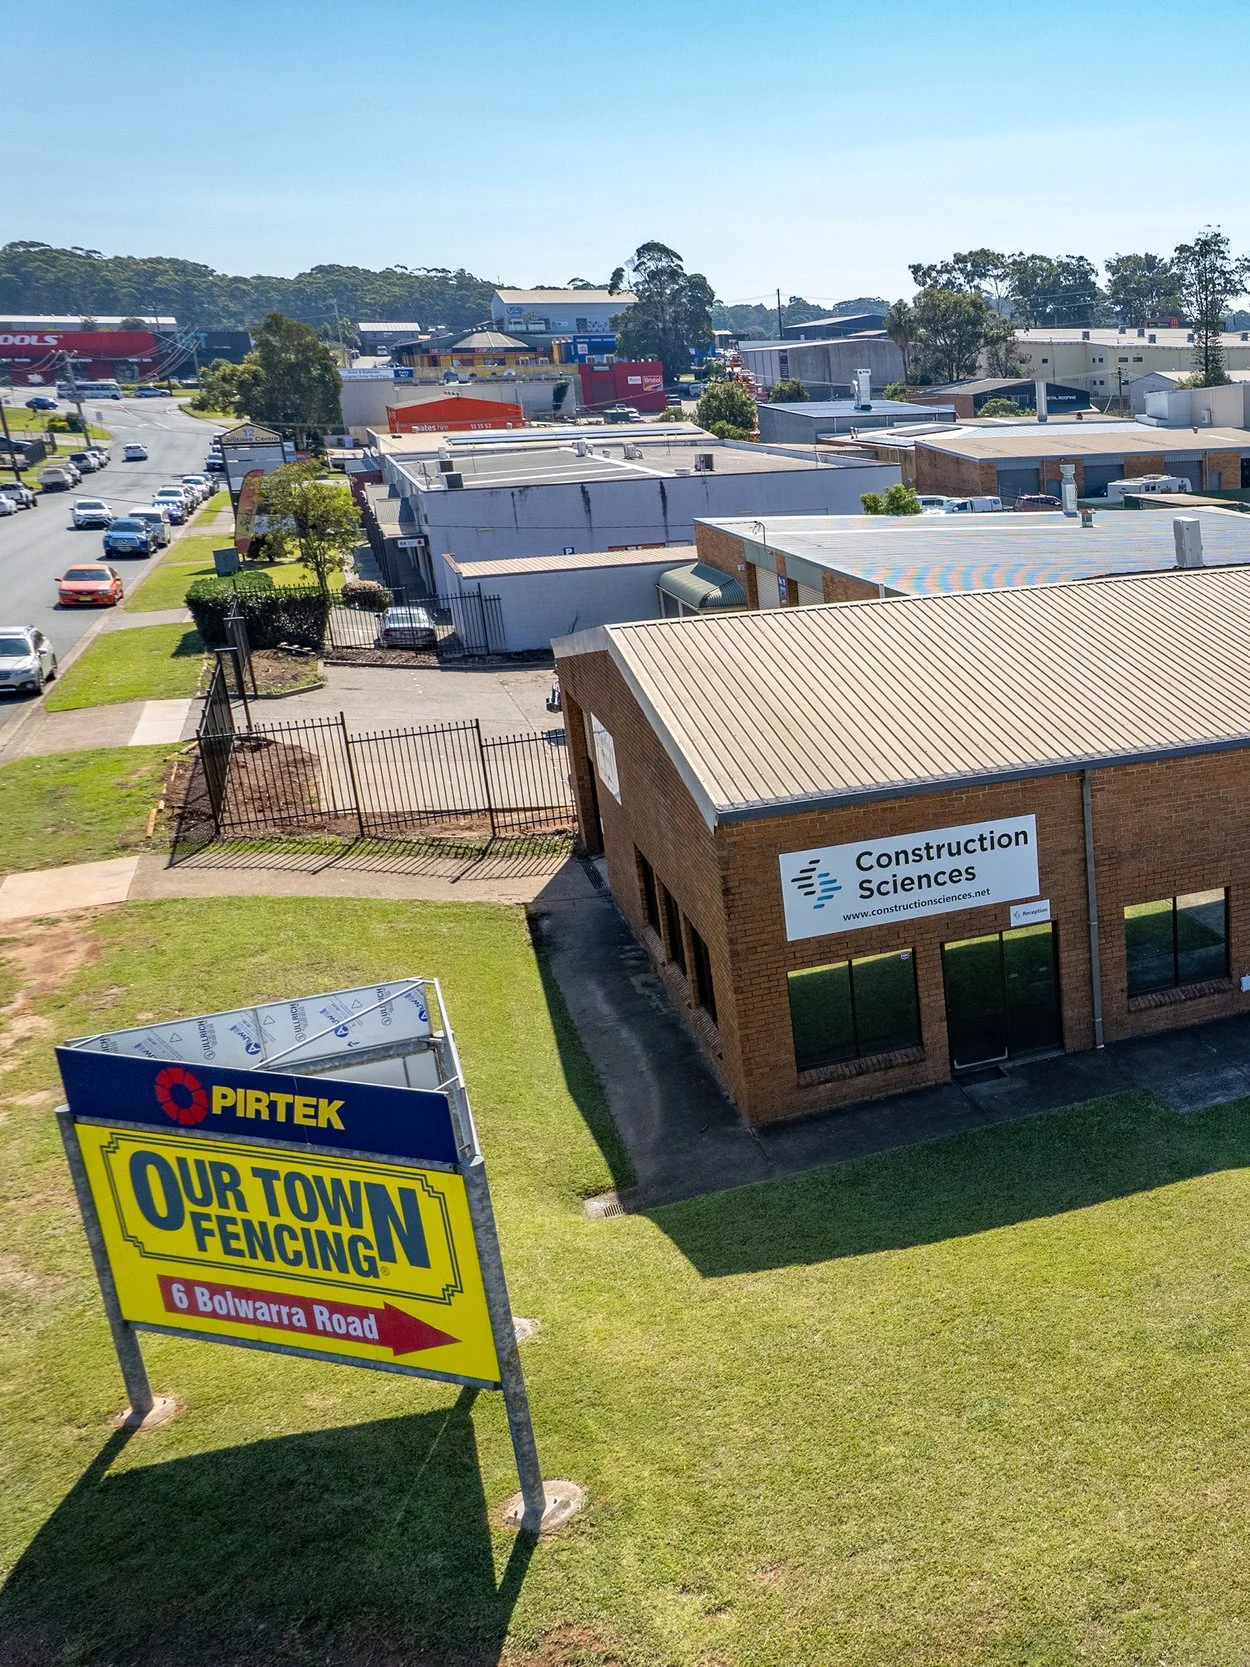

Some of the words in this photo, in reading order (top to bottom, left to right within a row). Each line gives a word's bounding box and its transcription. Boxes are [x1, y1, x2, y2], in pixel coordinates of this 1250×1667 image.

[855, 830, 1029, 872] Construction
[859, 865, 977, 900] Sciences
[842, 888, 991, 922] www.constructionsciences.net
[1022, 907, 1048, 917] Reception
[197, 1020, 211, 1051] ULLRICH
[289, 1003, 302, 1035] ULLRICH
[212, 1085, 346, 1130] PIRTEK
[129, 1150, 252, 1231] OUR
[252, 1167, 431, 1269] TOWN
[190, 1211, 380, 1279] FENCING
[171, 1282, 189, 1311] 6
[194, 1286, 308, 1328] Bolwarra
[313, 1305, 380, 1341] Road
